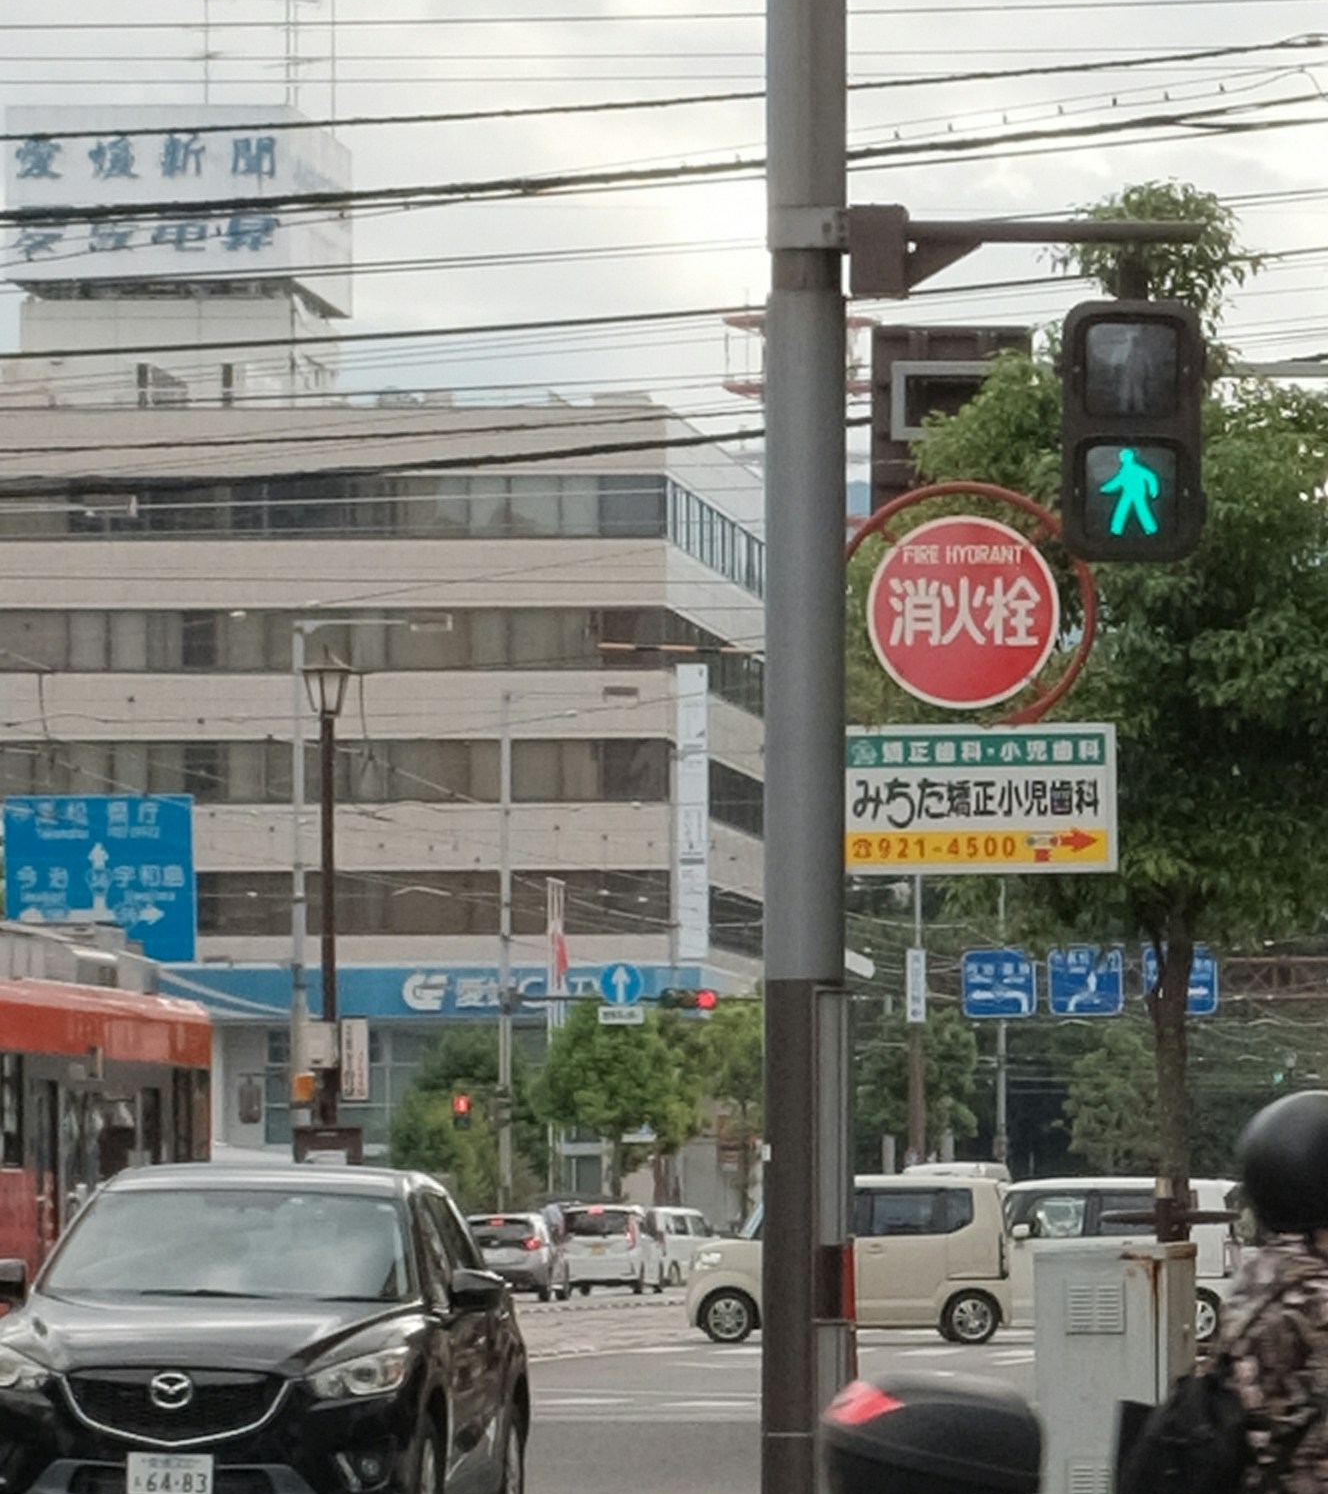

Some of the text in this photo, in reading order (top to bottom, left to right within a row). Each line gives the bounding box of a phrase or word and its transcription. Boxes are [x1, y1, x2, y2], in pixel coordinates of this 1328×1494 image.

[14, 134, 278, 187] 愛媛新聞
[902, 544, 1024, 565] FIRE HYDRANT
[888, 576, 1042, 646] 消火栓
[881, 739, 1100, 763] 矯正歯科・小児歯科
[877, 836, 1017, 858] 921-4500
